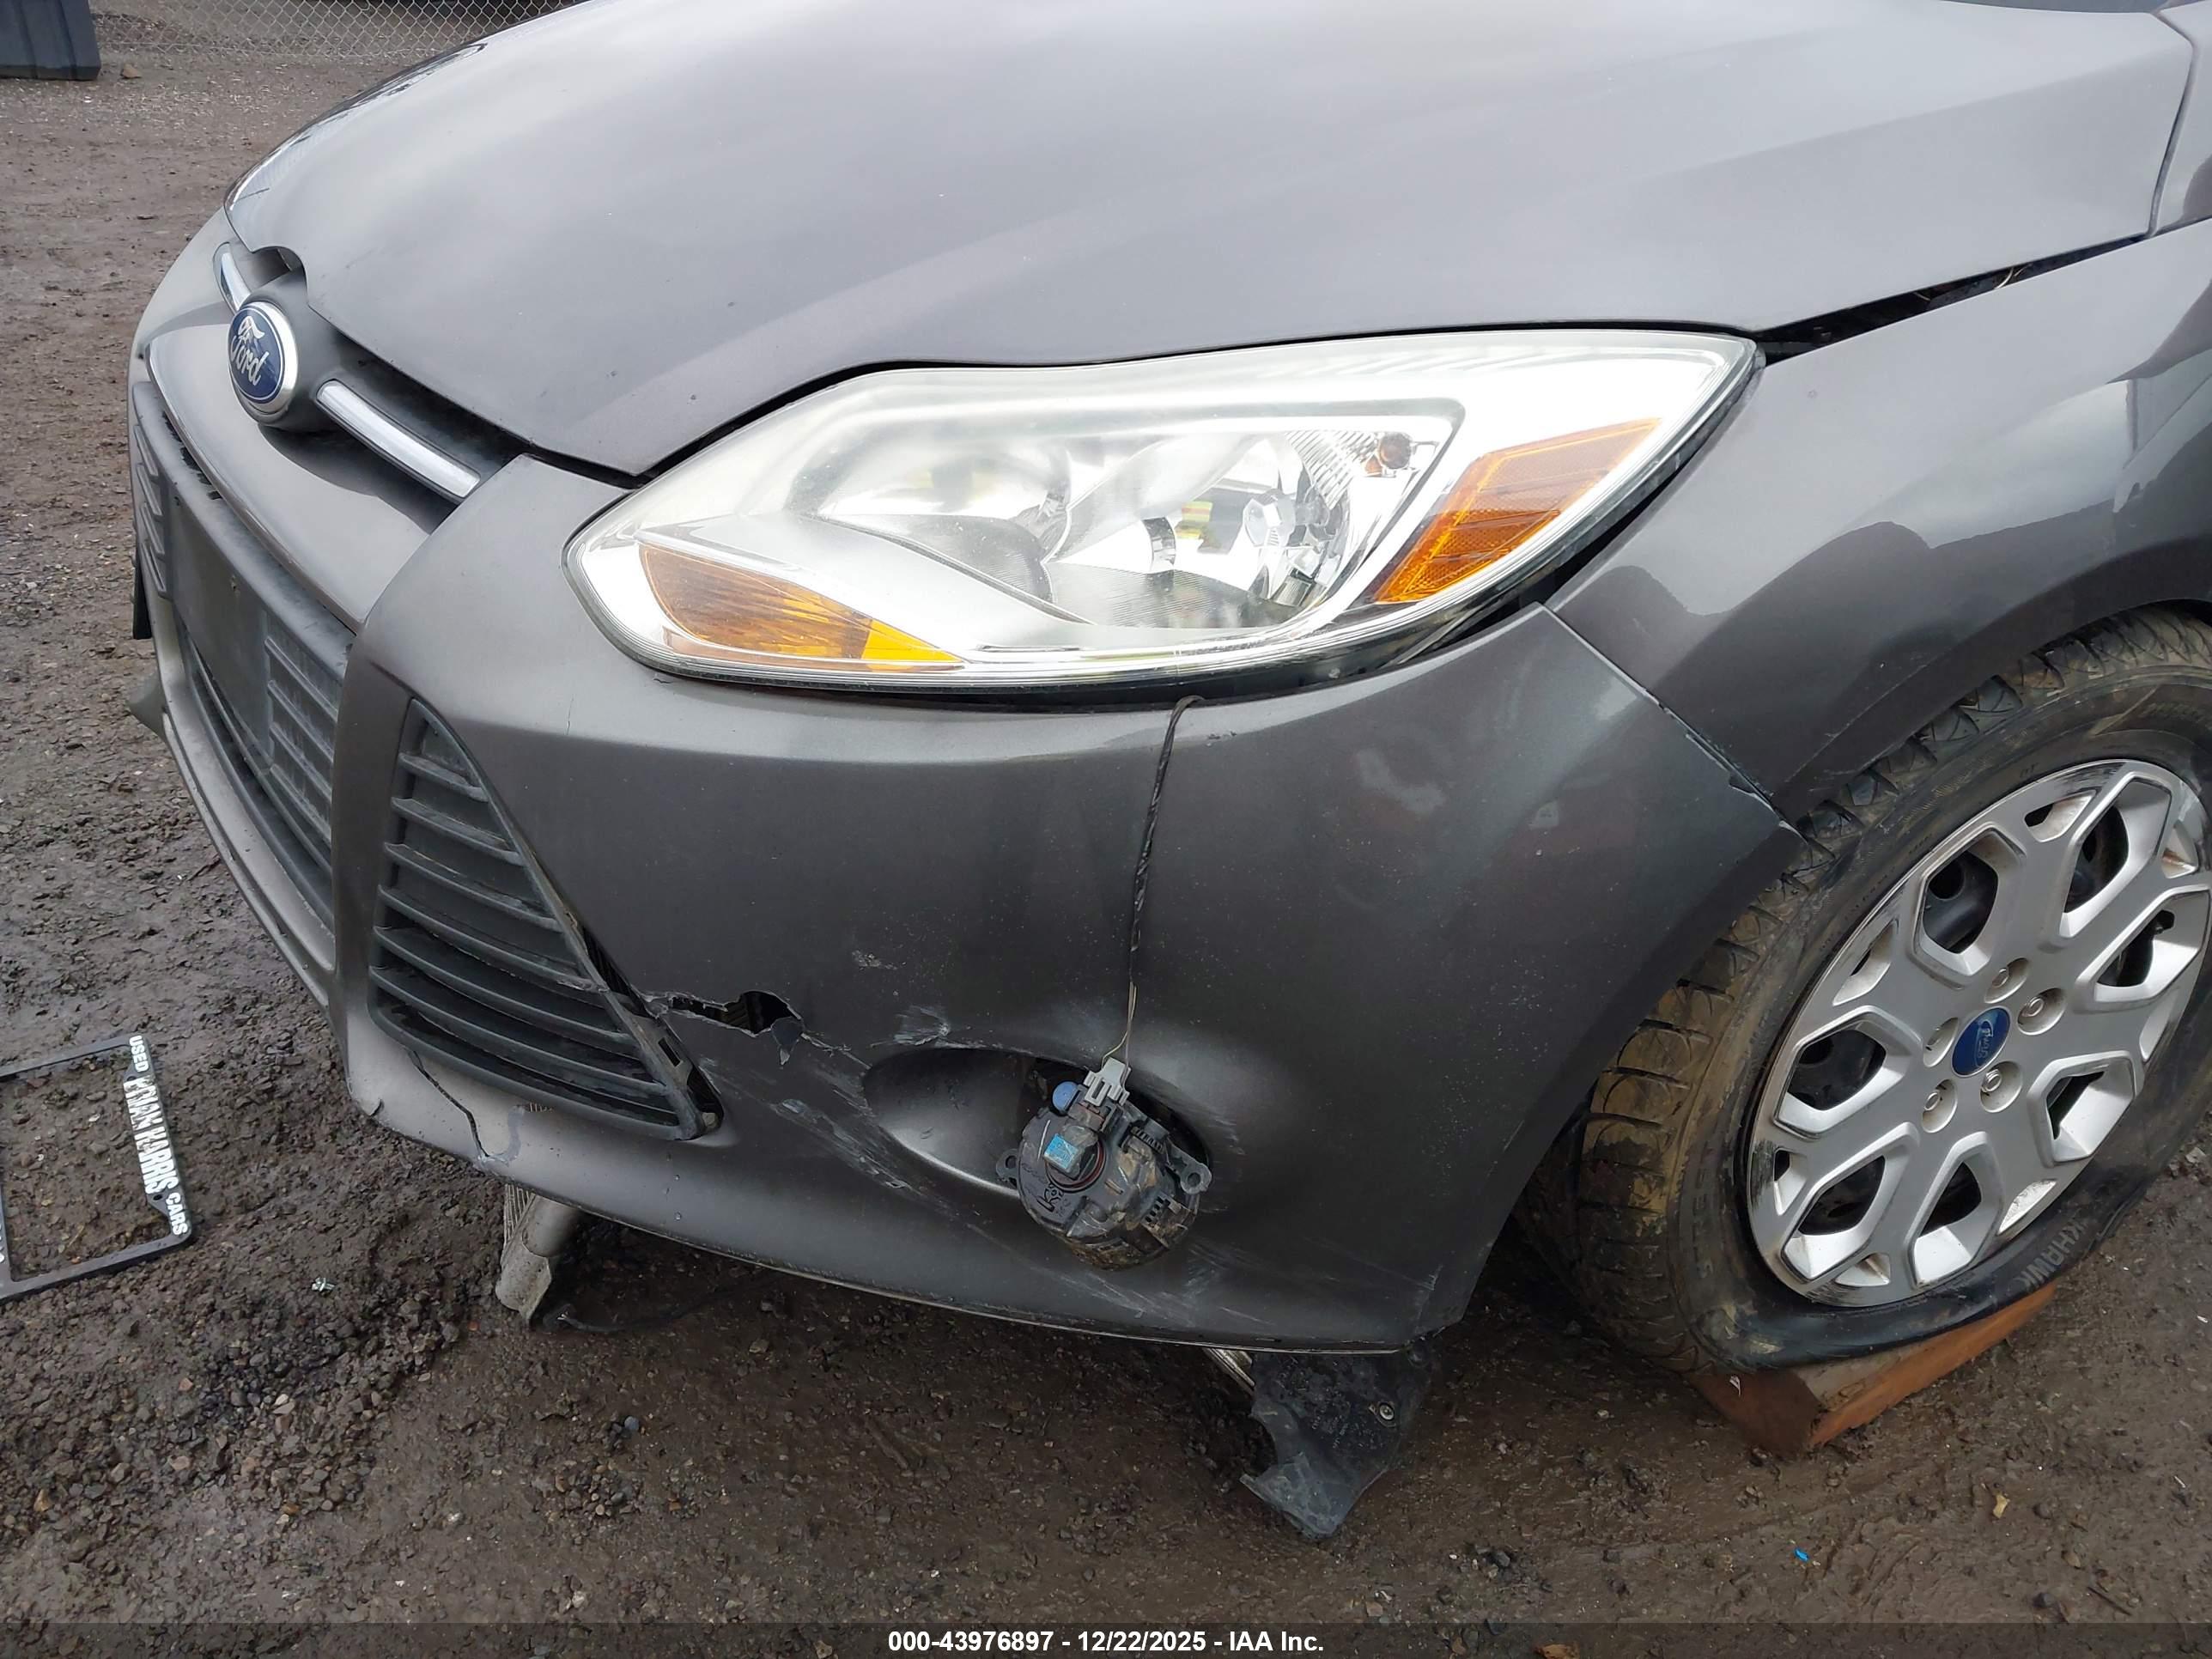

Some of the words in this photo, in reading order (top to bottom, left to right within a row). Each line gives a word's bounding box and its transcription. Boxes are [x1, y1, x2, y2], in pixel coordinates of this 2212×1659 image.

[229, 315, 270, 386] Ford
[129, 1035, 149, 1073] USED
[134, 1126, 179, 1194] HARRIS
[166, 1192, 188, 1236] CARS
